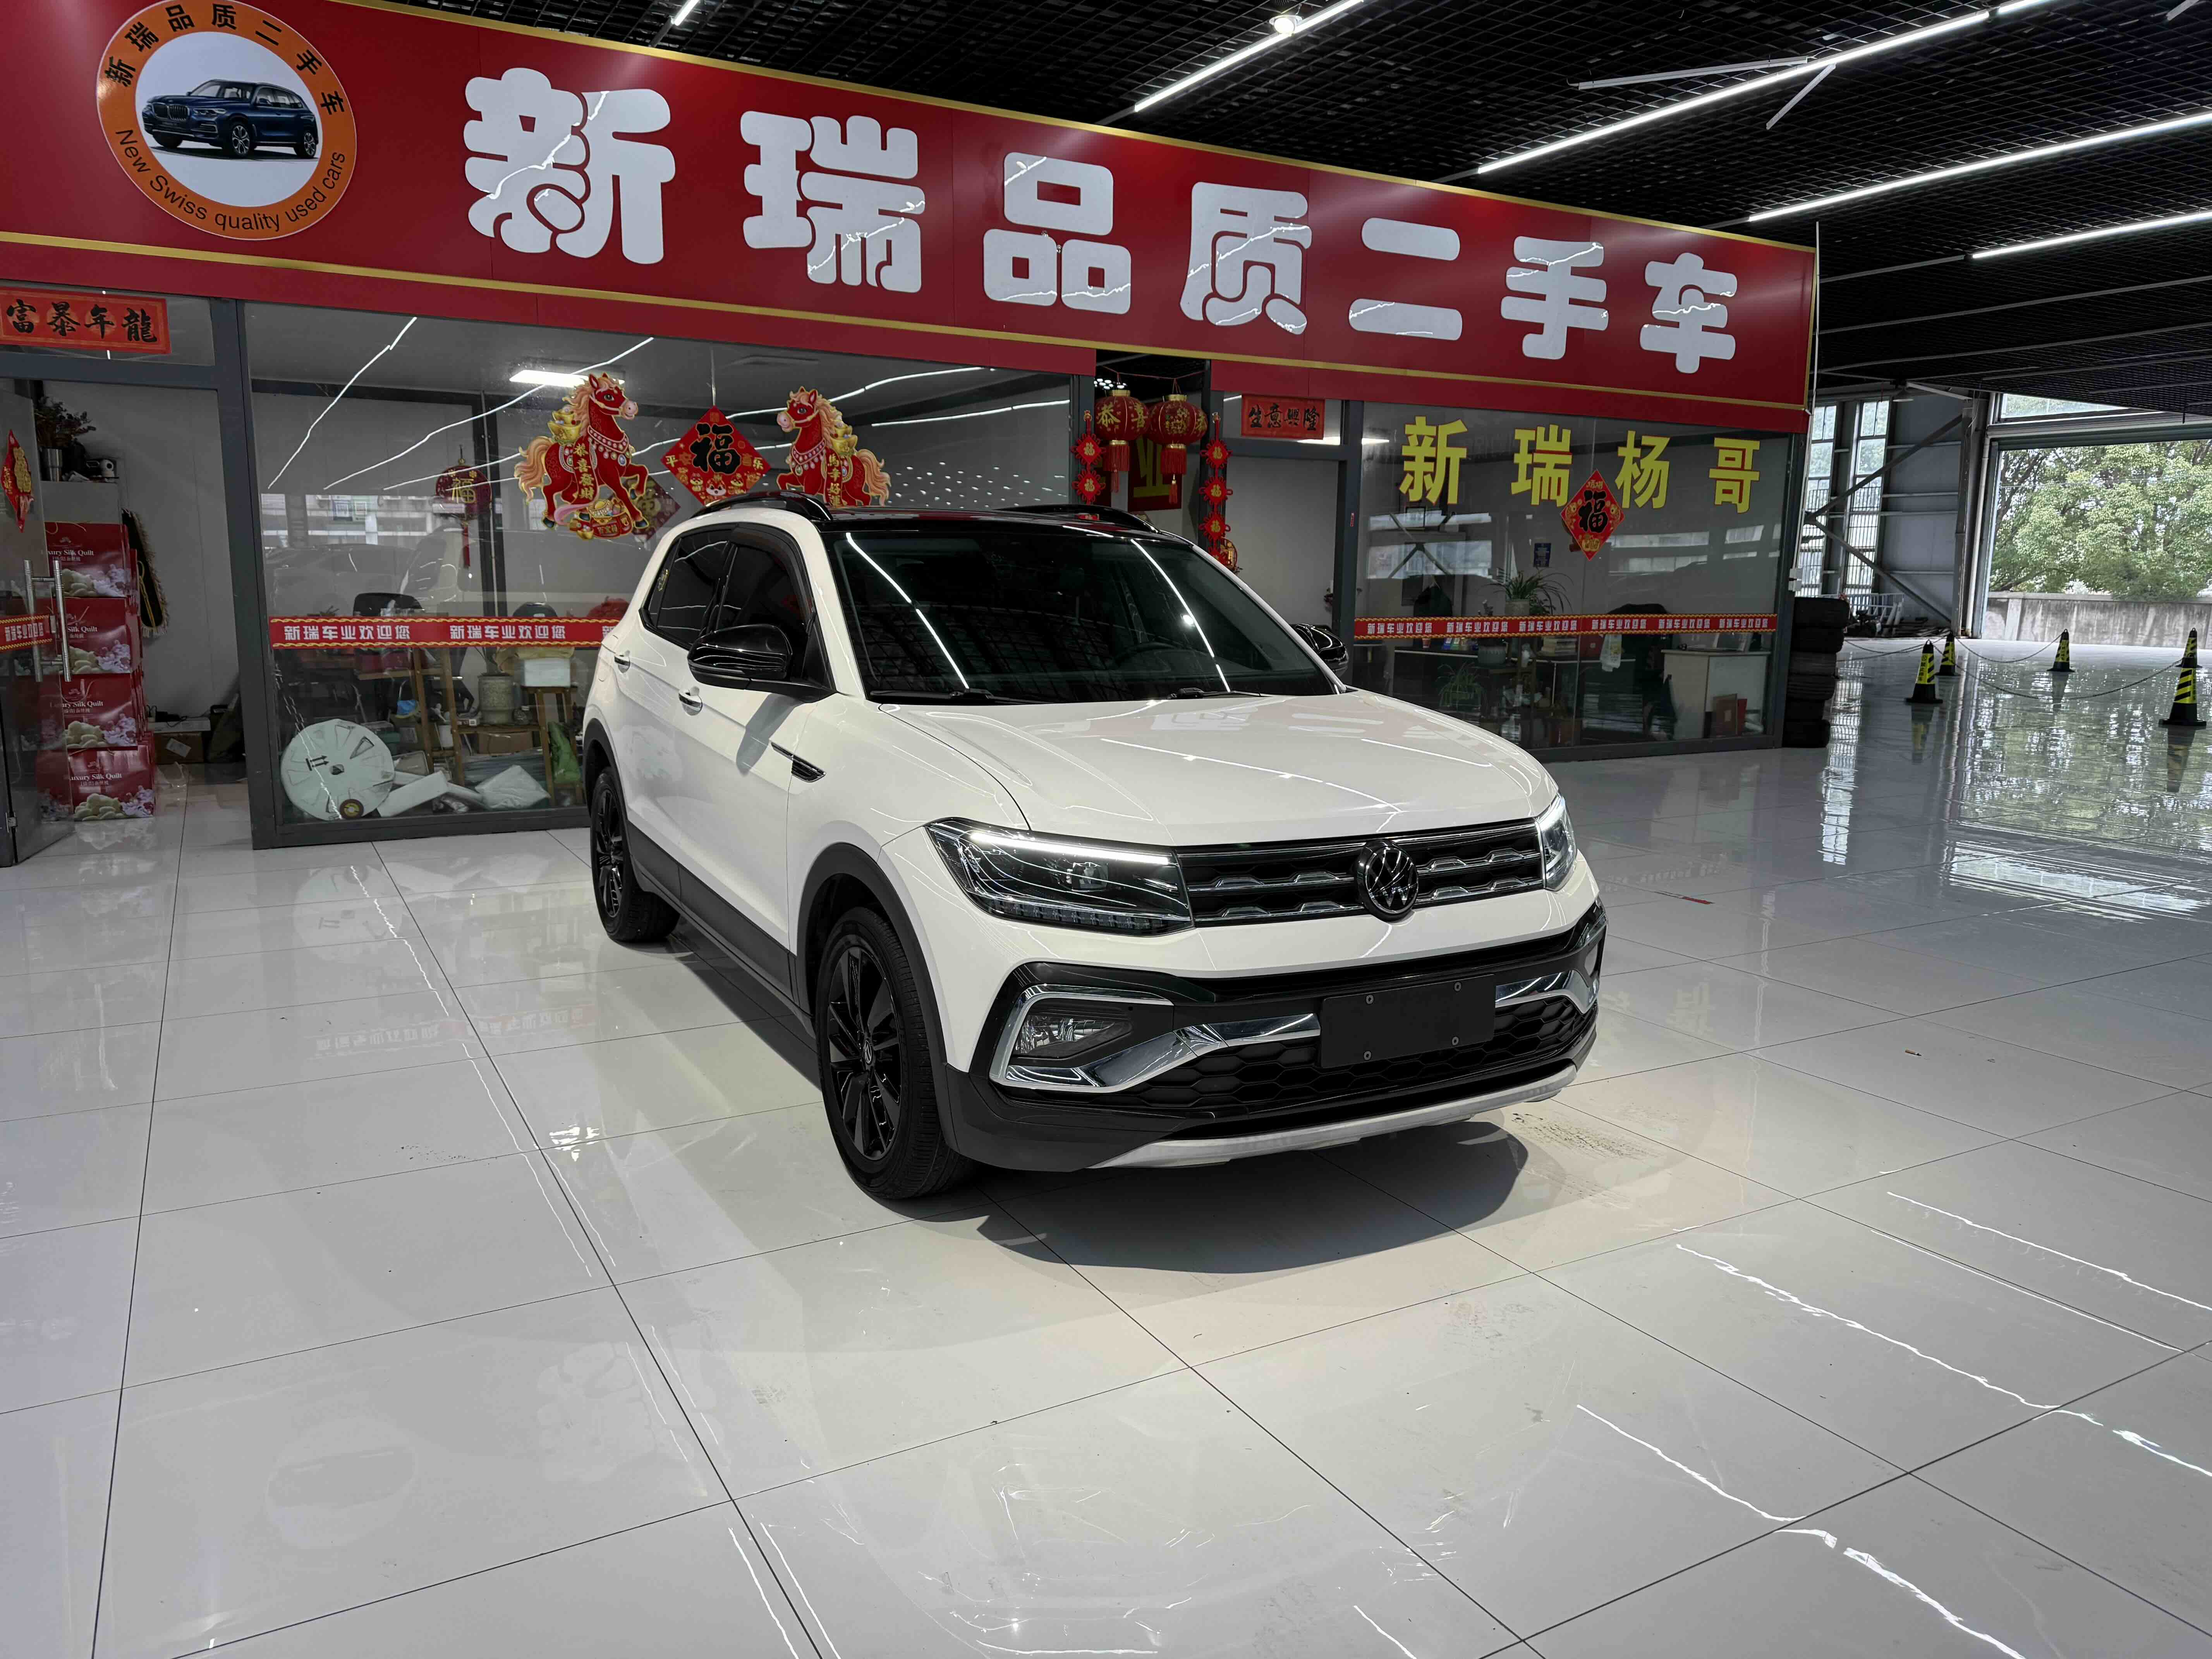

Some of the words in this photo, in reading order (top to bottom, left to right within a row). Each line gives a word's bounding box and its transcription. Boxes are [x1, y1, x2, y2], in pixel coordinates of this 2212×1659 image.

[104, 3, 345, 115] 新瑞品质二手车
[116, 129, 151, 173] New
[150, 175, 207, 220] Swiss
[215, 213, 280, 232] quality
[285, 187, 326, 223] used
[322, 151, 345, 189] cars
[464, 67, 1737, 373] 新瑞品质二手车
[1248, 402, 1320, 431] 生意興隆
[573, 443, 595, 500] 恭喜發財
[689, 422, 741, 475] 福
[1399, 416, 1761, 514] 新瑞杨哥
[1578, 489, 1608, 533] 福
[284, 625, 410, 641] 新瑞车业欢迎您
[449, 625, 566, 639] 新瑞车业欢迎您
[1367, 622, 1432, 634] 新瑞车业欢迎您
[1446, 621, 1508, 632] 新瑞车业欢迎您
[1519, 620, 1577, 632] 新瑞车业欢迎您
[1592, 619, 1647, 630] 新瑞车业欢迎您
[1658, 619, 1711, 629] 新瑞车业欢迎您
[1719, 618, 1769, 628] 新瑞车业欢迎您
